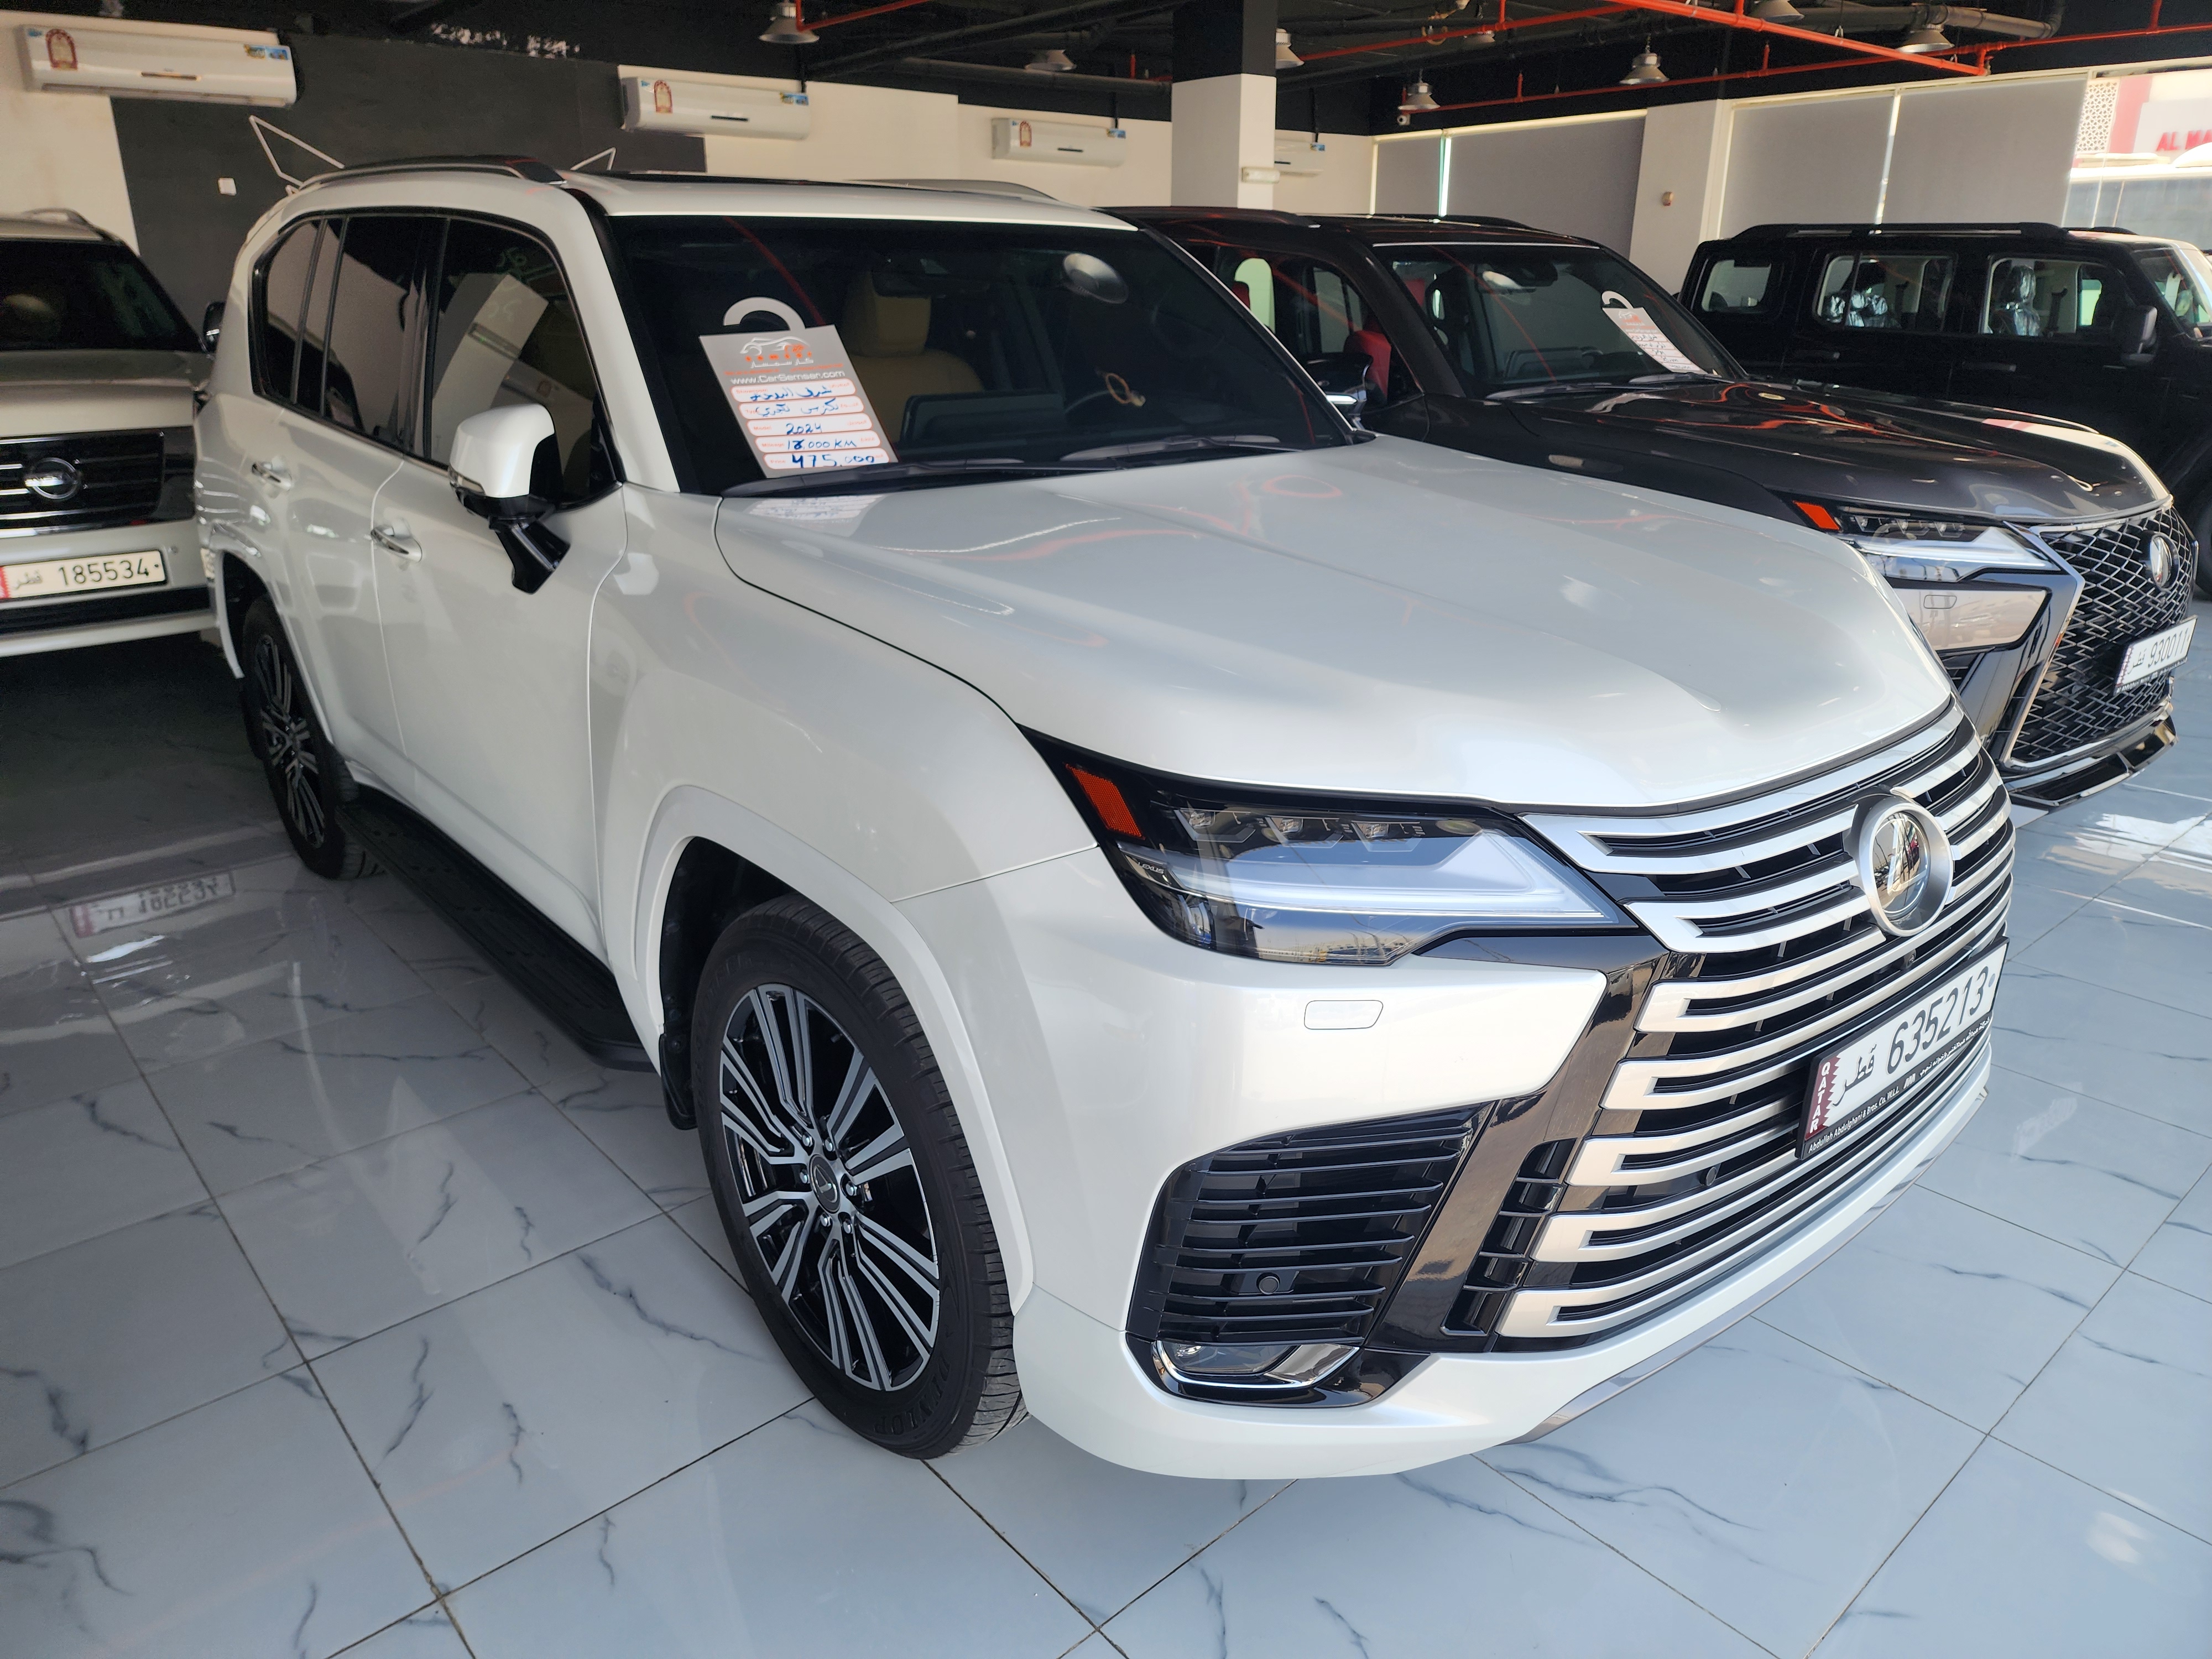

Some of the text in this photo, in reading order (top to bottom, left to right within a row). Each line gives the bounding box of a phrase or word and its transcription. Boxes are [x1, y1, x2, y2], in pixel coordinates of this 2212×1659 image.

[2156, 131, 2179, 151] AL
[730, 370, 846, 385] www.CarSemsar.com
[786, 422, 822, 435] 2024
[834, 438, 857, 450] KM
[791, 453, 875, 468] 475.000
[58, 558, 149, 587] 185534
[2147, 627, 2189, 668] 930011
[1138, 862, 1165, 874] LEXUS
[1886, 966, 1989, 1074] 635213
[1832, 1043, 1877, 1107] قطر
[1809, 1061, 1830, 1134] QATAR
[1808, 1132, 1833, 1154] Abdullah
[1833, 1111, 1863, 1138] Abdulghani
